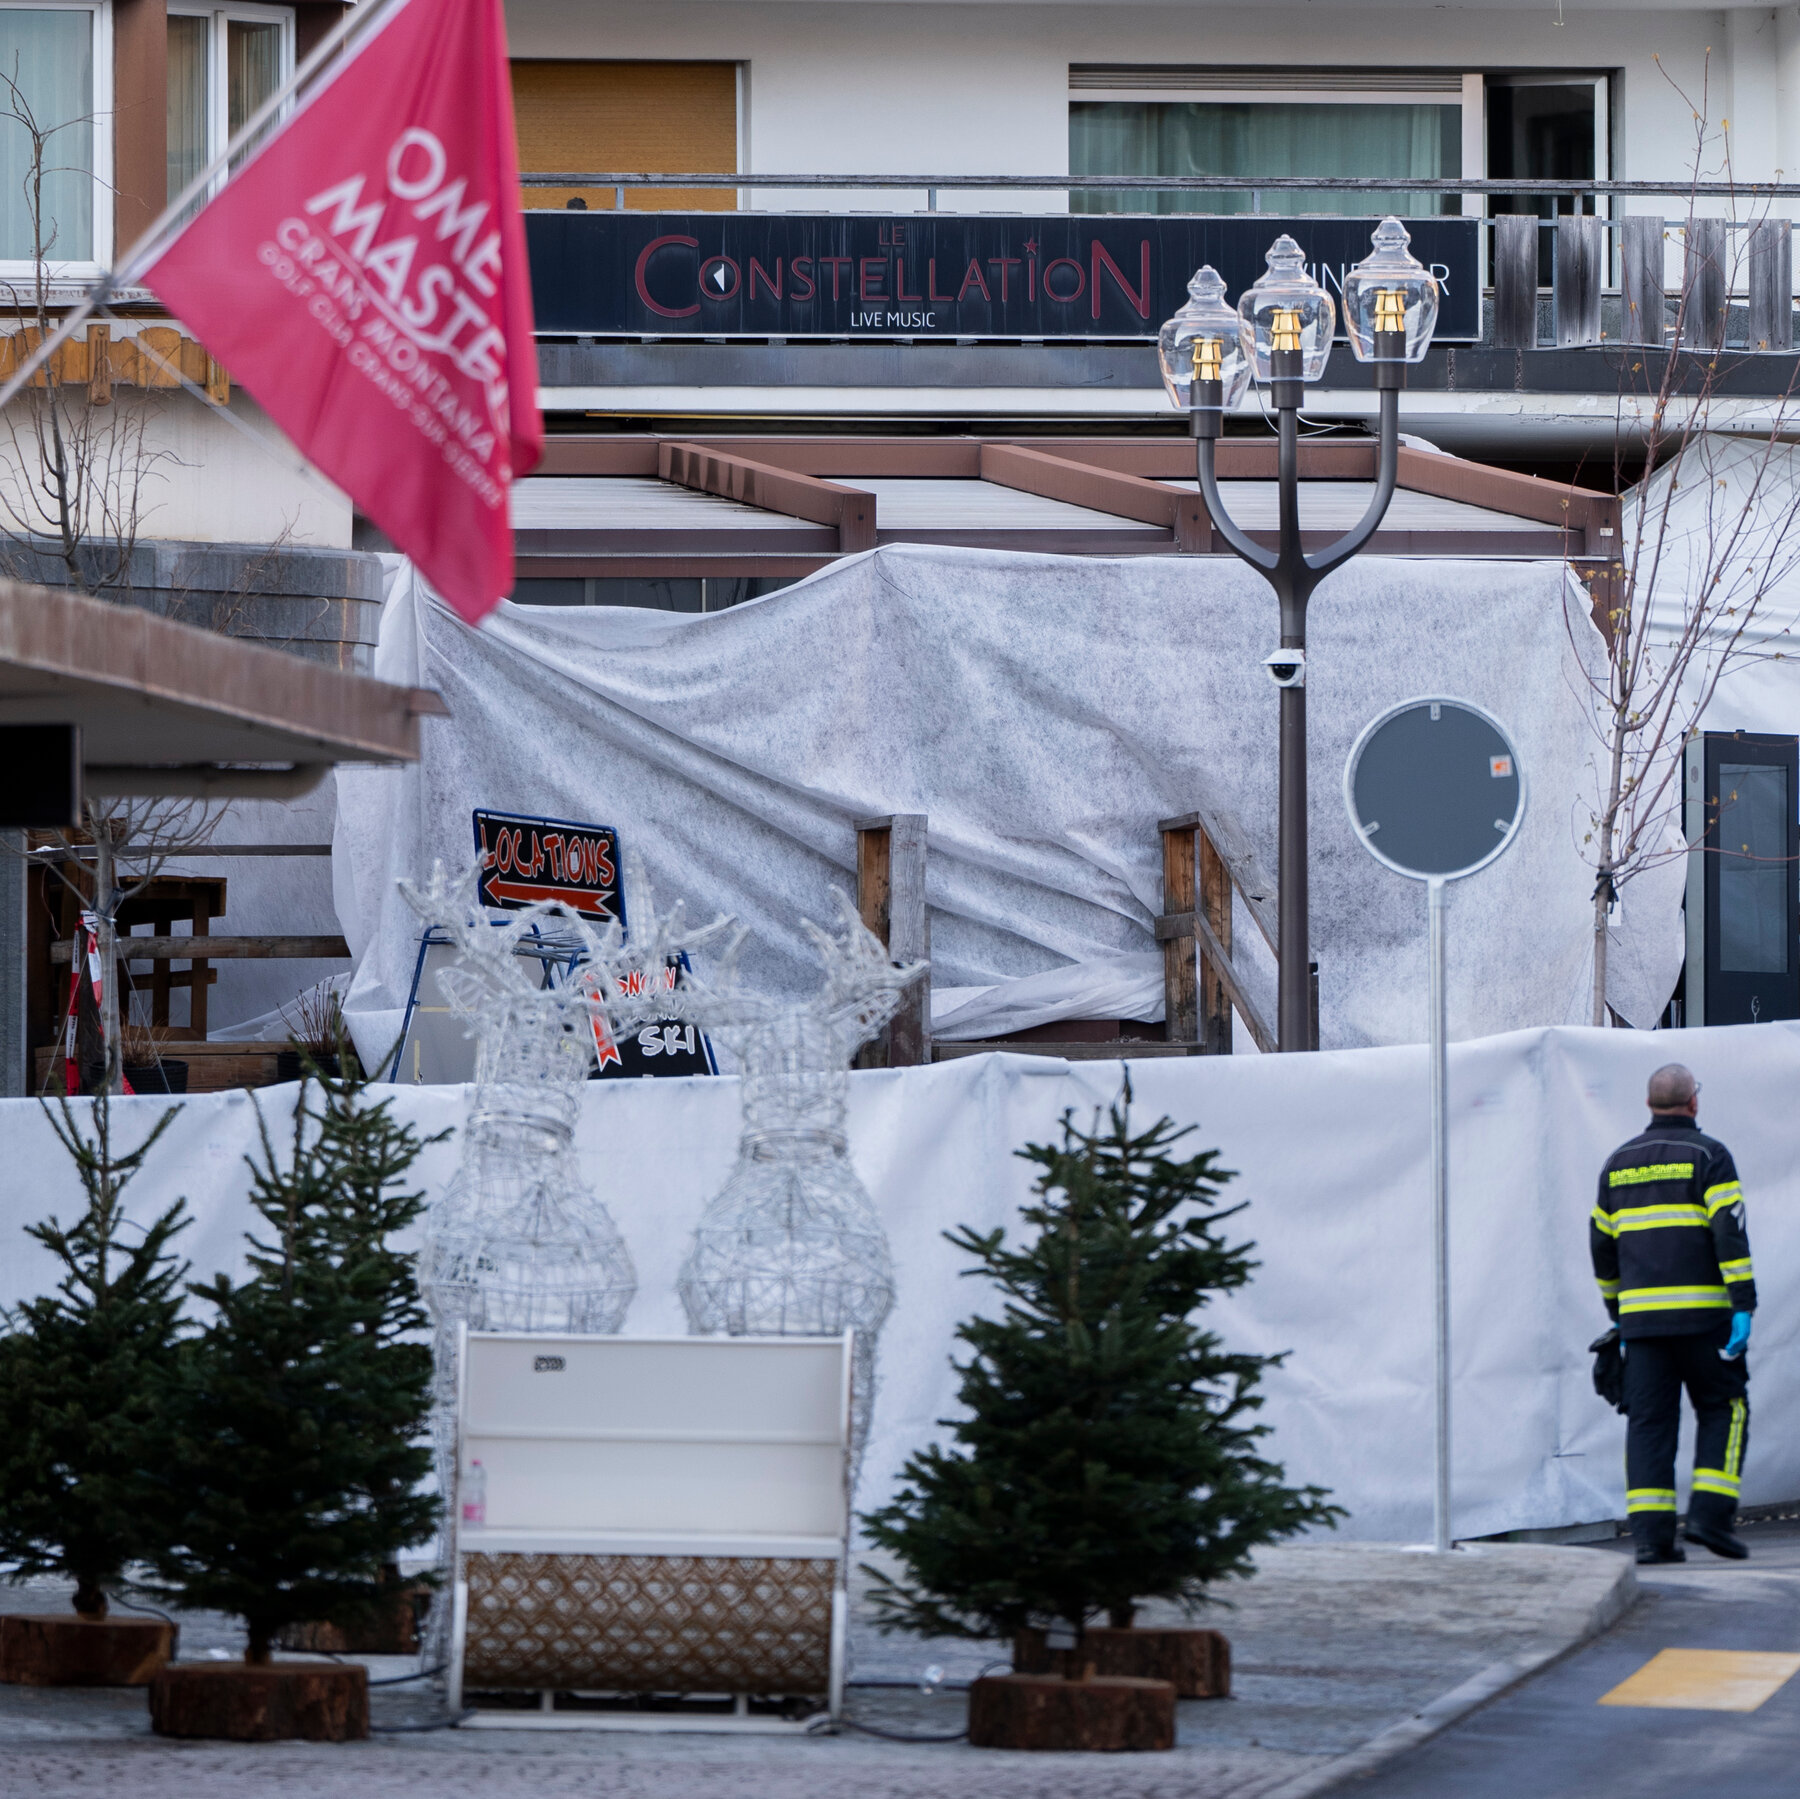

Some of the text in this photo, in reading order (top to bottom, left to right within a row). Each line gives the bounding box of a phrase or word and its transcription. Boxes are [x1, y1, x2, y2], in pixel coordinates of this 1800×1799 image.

[879, 226, 905, 247] LE
[850, 312, 936, 328] LIVE MUSIC
[276, 217, 496, 464] CRANS MONTANA
[480, 823, 616, 887] LOCATIONS
[638, 1024, 696, 1057] SKI
